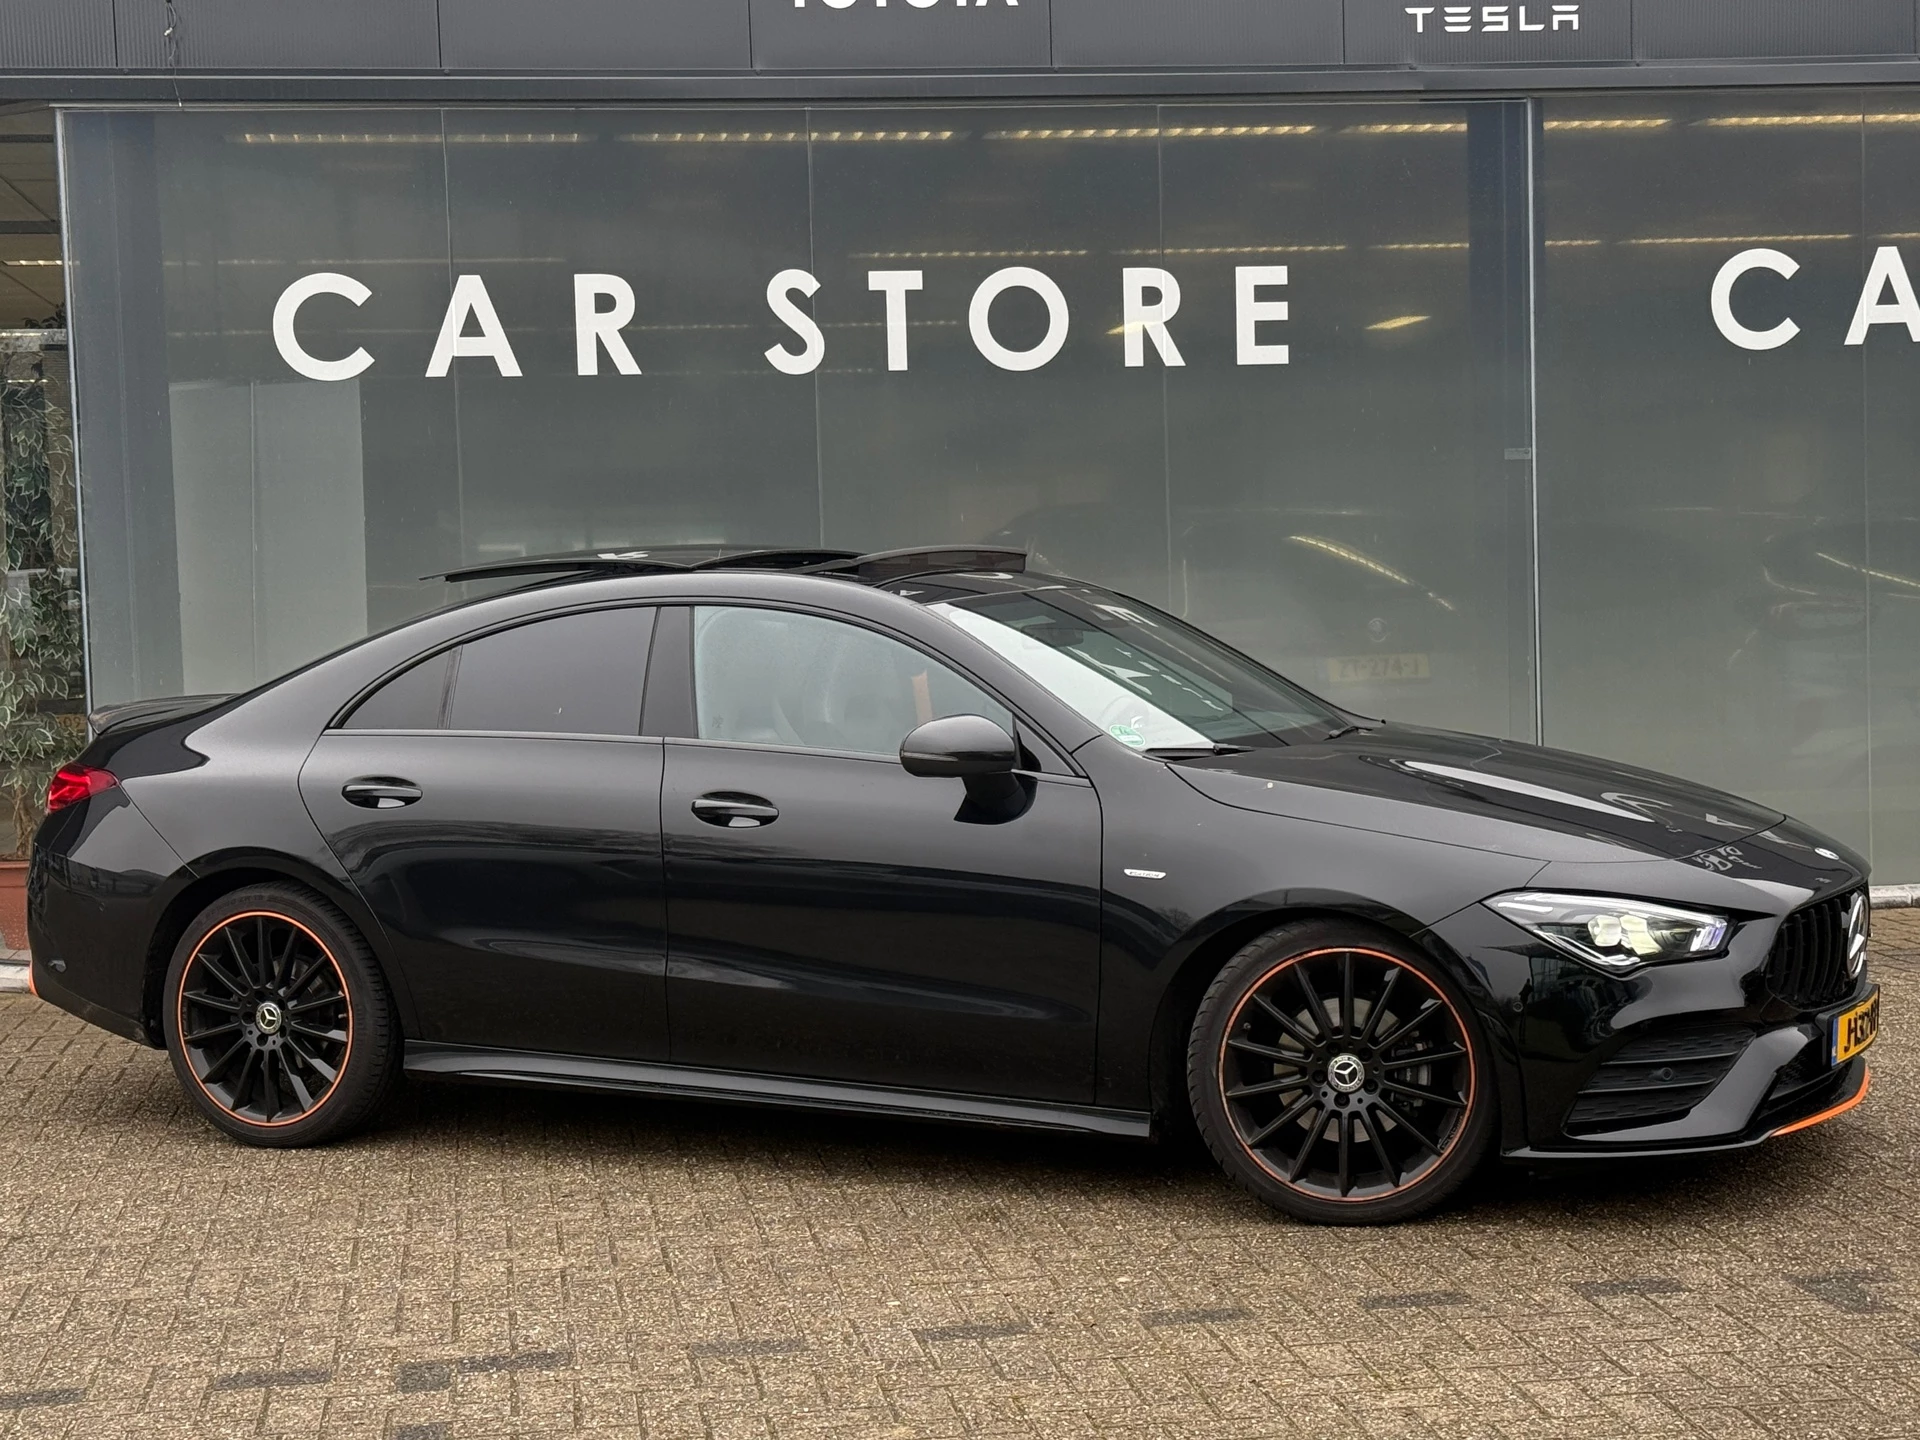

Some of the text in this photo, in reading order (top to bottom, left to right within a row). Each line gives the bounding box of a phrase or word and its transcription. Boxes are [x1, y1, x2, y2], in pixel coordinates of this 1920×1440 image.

[1404, 4, 1580, 33] TESLA
[272, 265, 1290, 382] CAR STORE
[1710, 245, 1920, 351] CA
